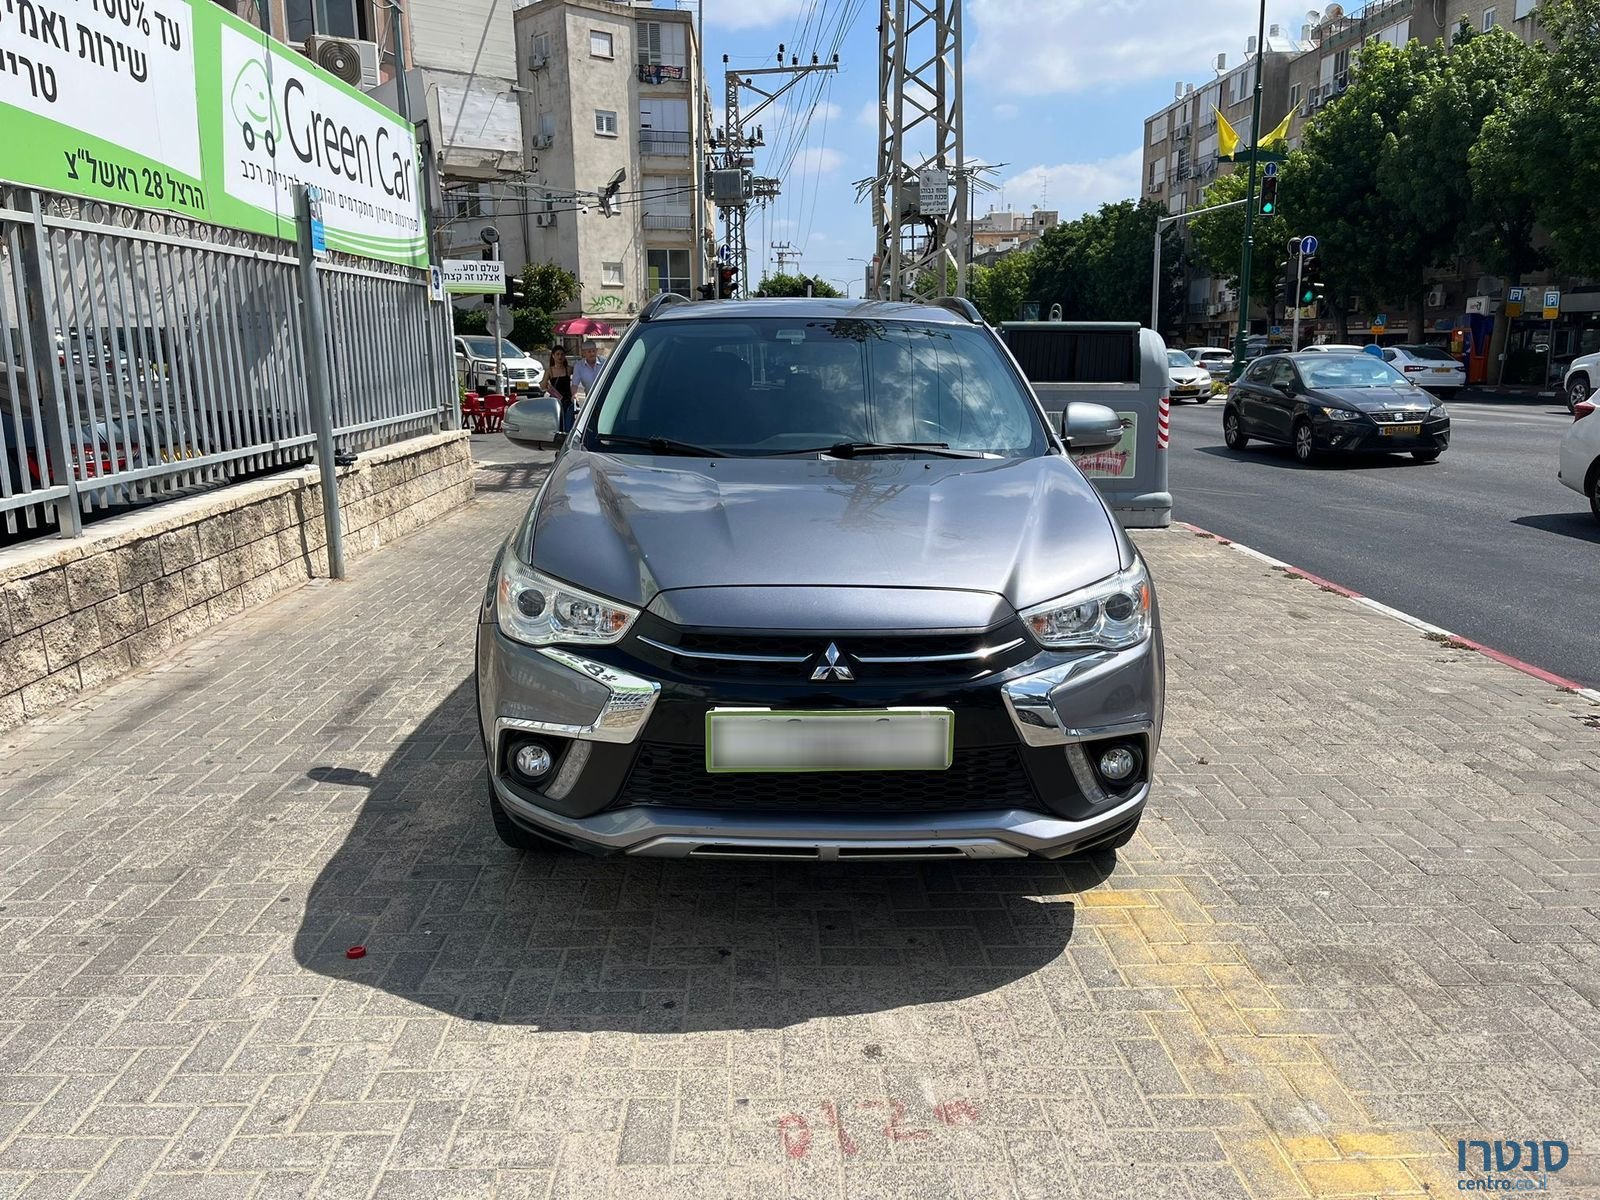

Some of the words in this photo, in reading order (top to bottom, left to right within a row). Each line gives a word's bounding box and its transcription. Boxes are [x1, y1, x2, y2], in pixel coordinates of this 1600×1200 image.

[154, 11, 181, 51] עד
[76, 23, 147, 82] שירות
[284, 78, 374, 188] Green
[376, 126, 411, 203] Car
[142, 168, 164, 199] 28
[241, 160, 263, 183] רכב
[166, 172, 205, 210] הרצל
[339, 193, 374, 218] מתקדמים
[477, 273, 500, 282] אצלנו
[481, 263, 500, 272] שלם
